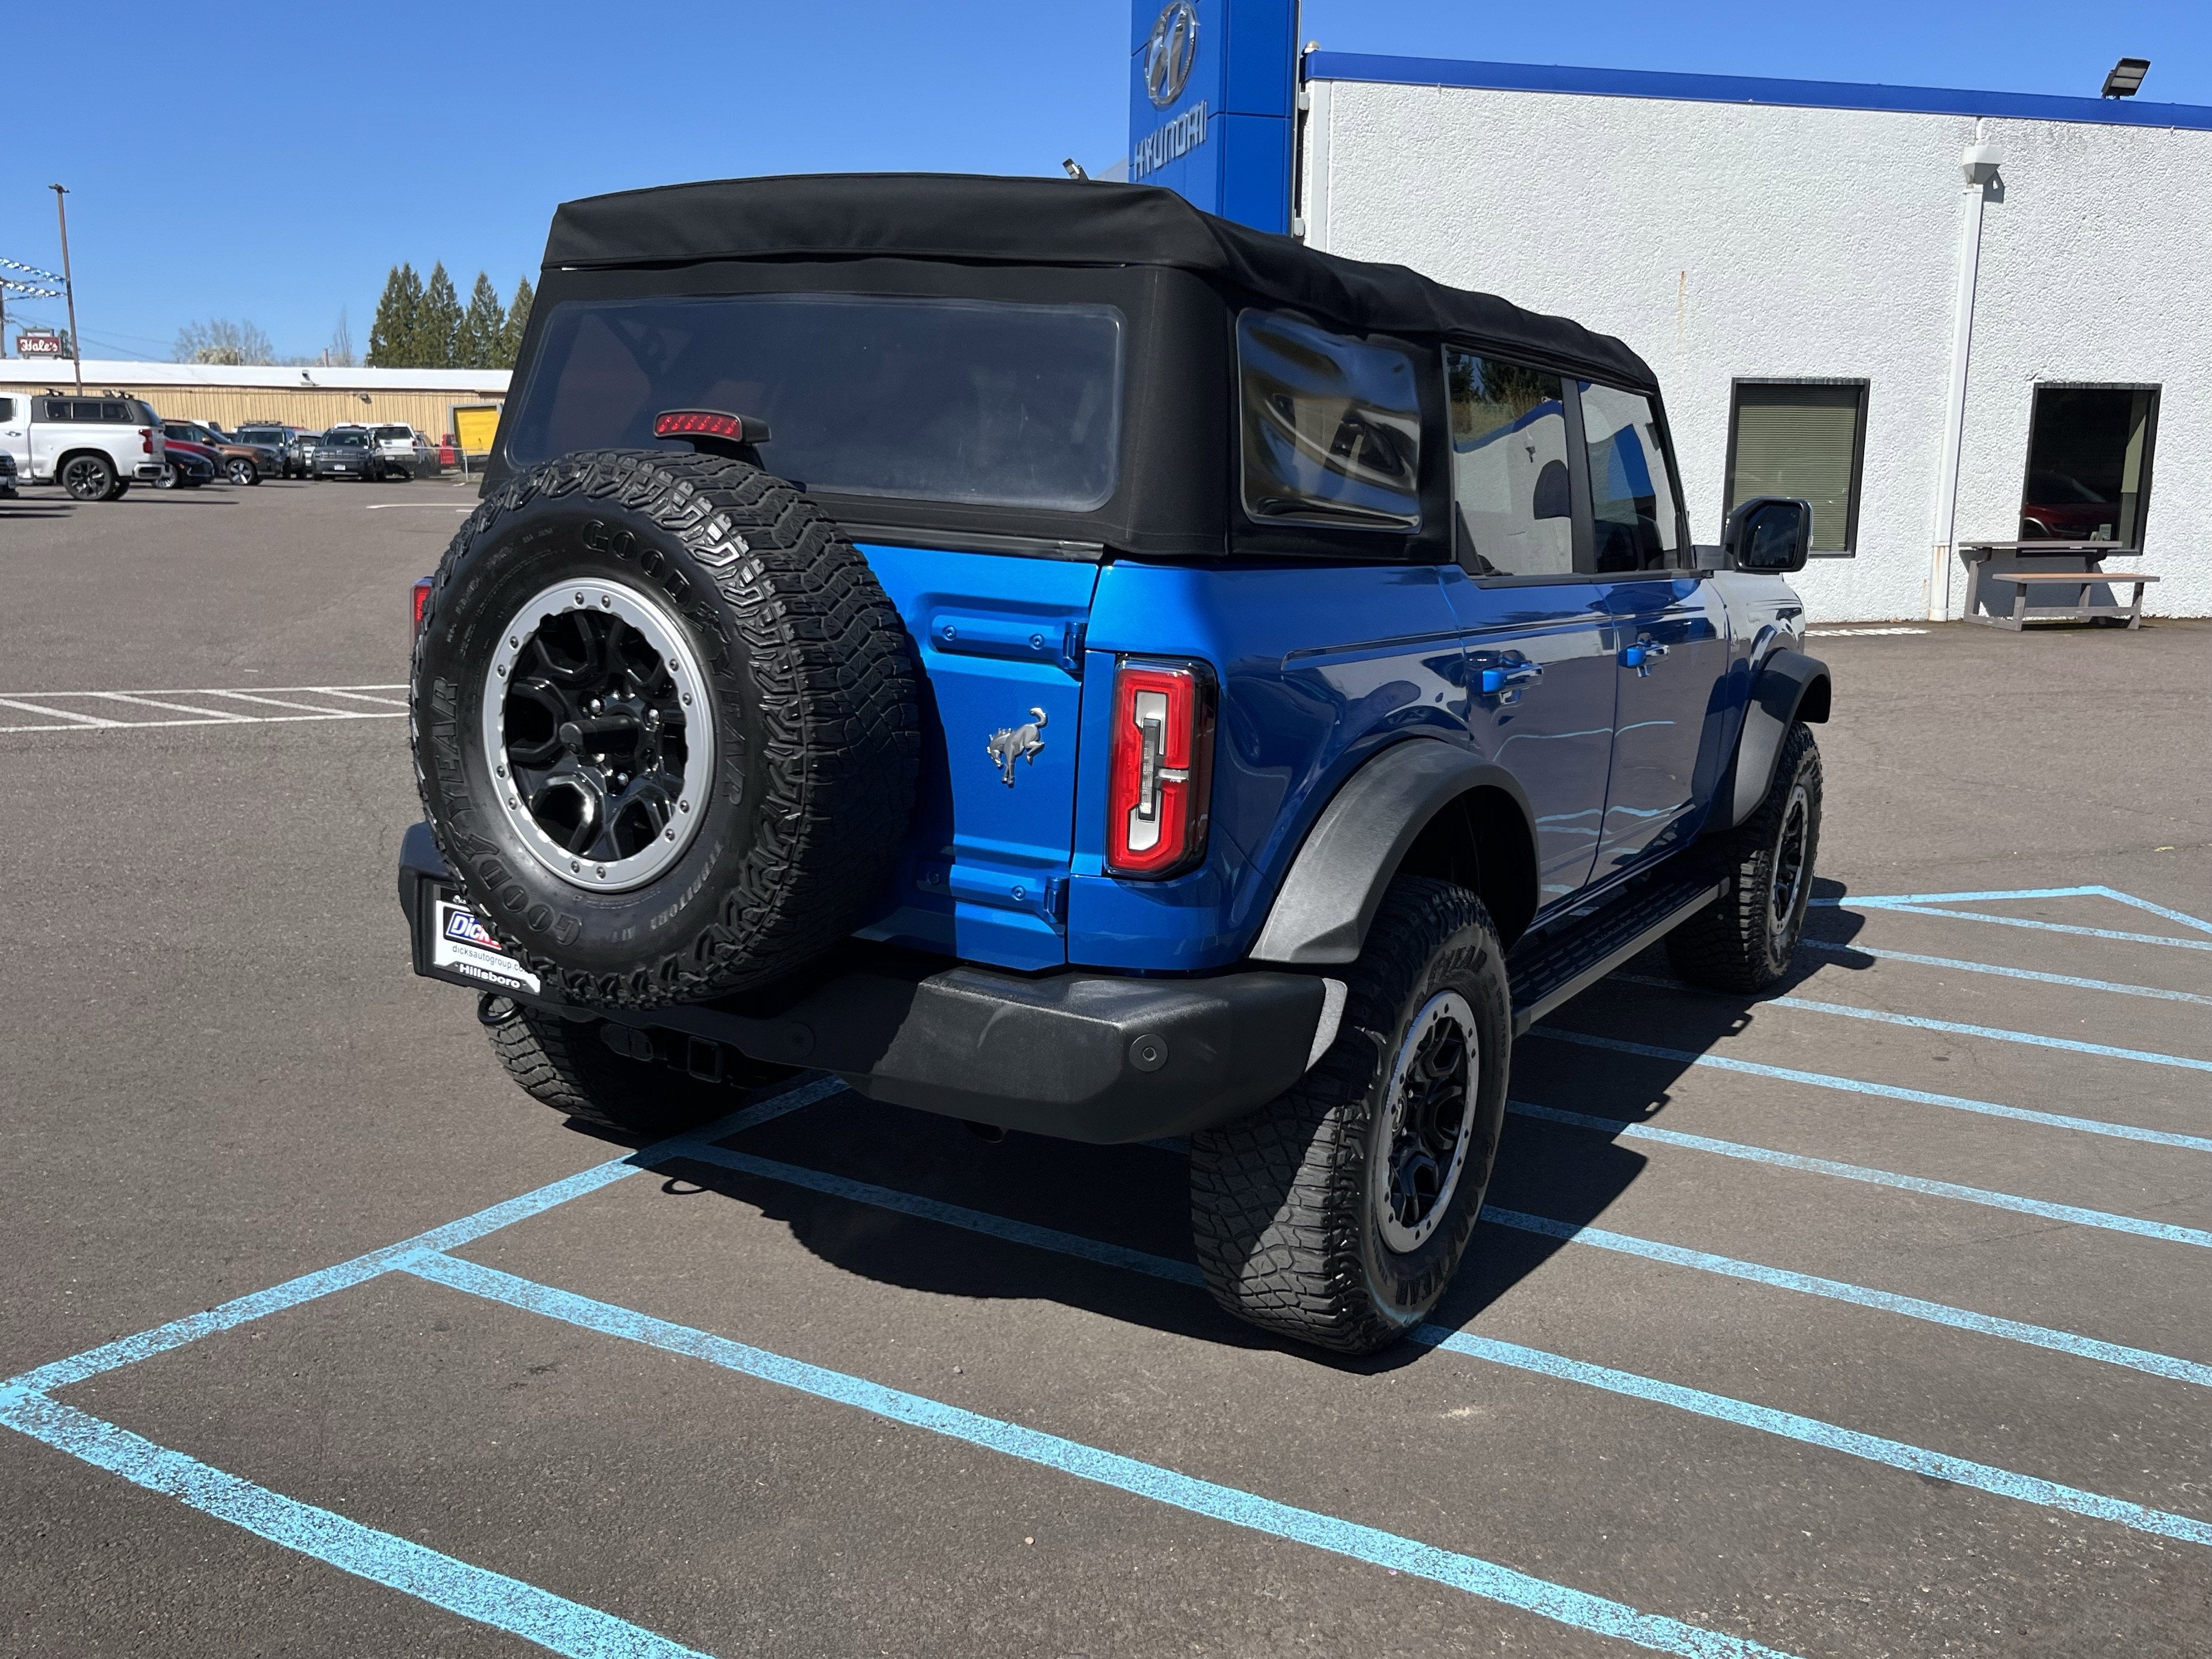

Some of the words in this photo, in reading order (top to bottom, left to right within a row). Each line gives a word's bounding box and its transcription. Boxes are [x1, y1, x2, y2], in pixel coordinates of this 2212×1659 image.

[1134, 99, 1207, 182] HYUNDAI
[20, 338, 58, 352] Hale's
[450, 915, 499, 945] Dick
[452, 945, 524, 972] dicksautogroup.co
[459, 963, 521, 989] Hillsboro
